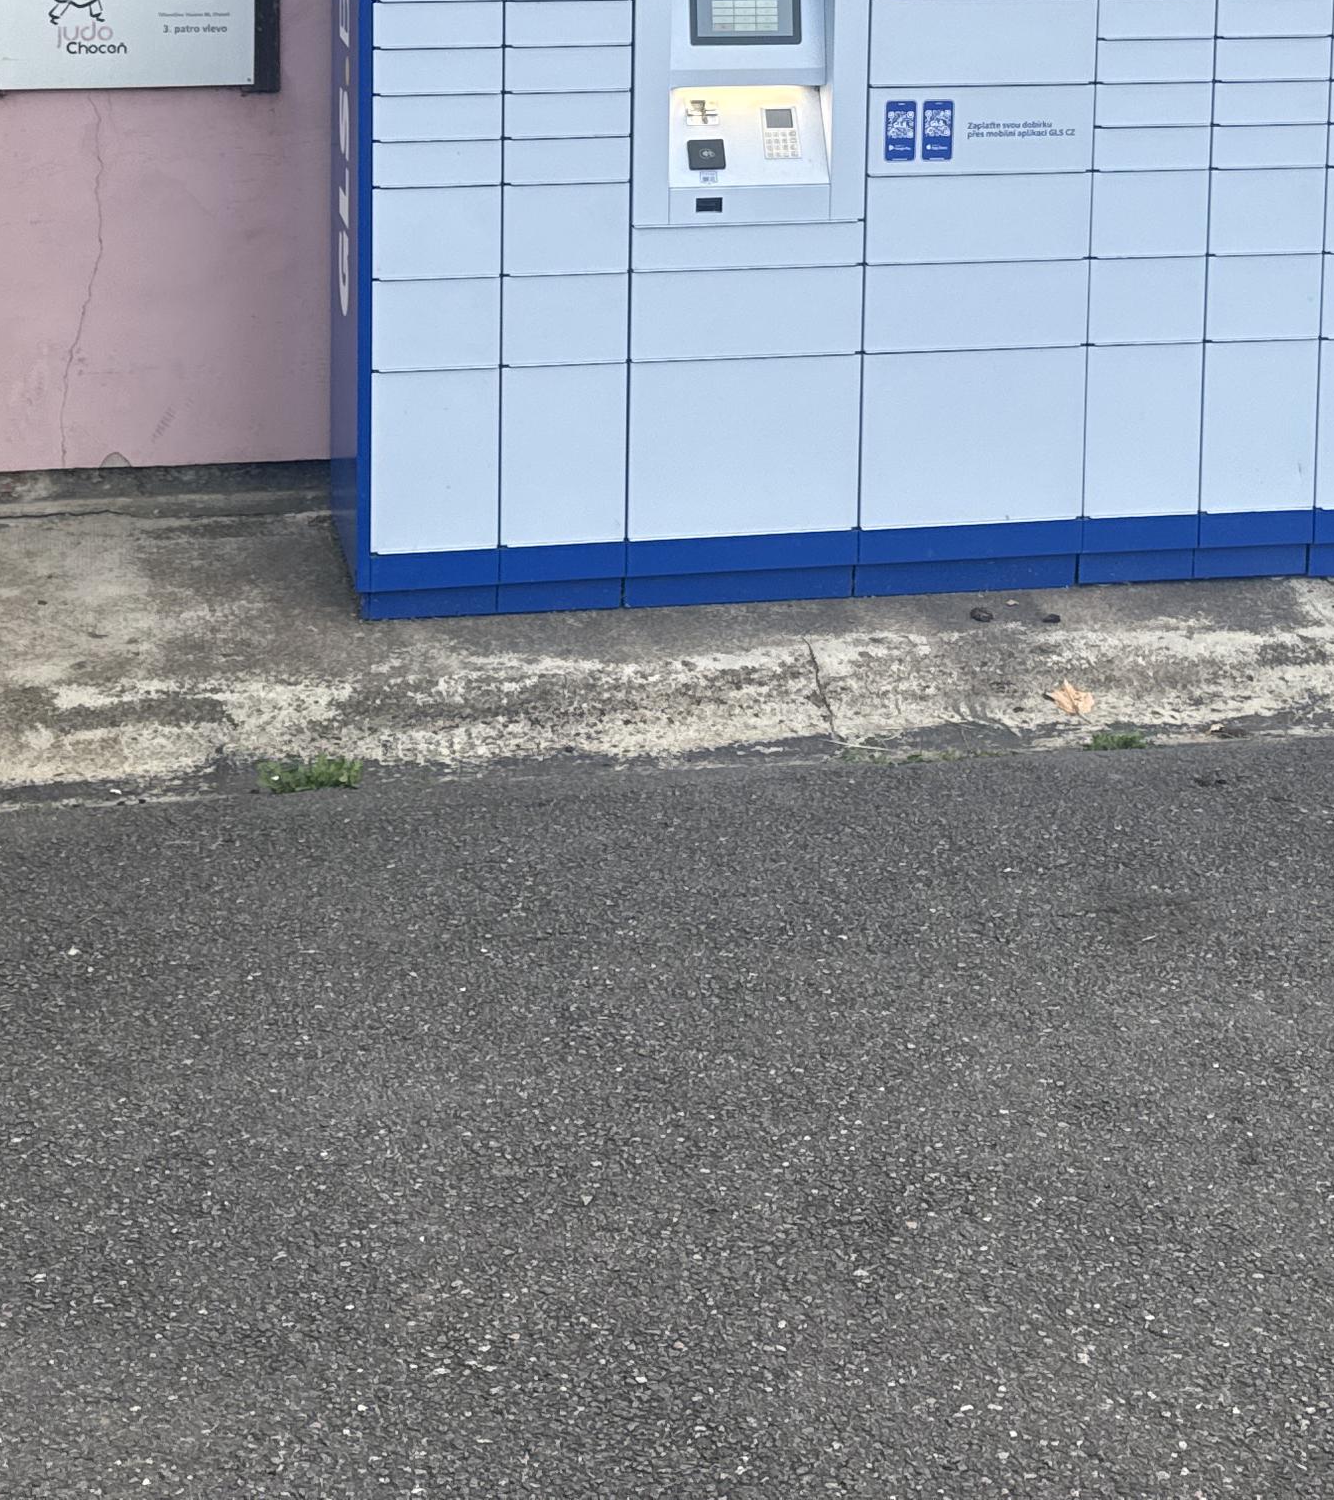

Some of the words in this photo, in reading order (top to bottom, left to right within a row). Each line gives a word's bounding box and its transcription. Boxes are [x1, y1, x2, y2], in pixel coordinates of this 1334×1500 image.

[56, 21, 114, 49] judo
[174, 24, 200, 35] patro
[203, 24, 228, 33] vlevo
[66, 41, 128, 55] Choceň
[1002, 122, 1020, 130] svou
[967, 129, 984, 140] přes
[1049, 128, 1064, 137] GLS
[1065, 128, 1076, 137] CZ
